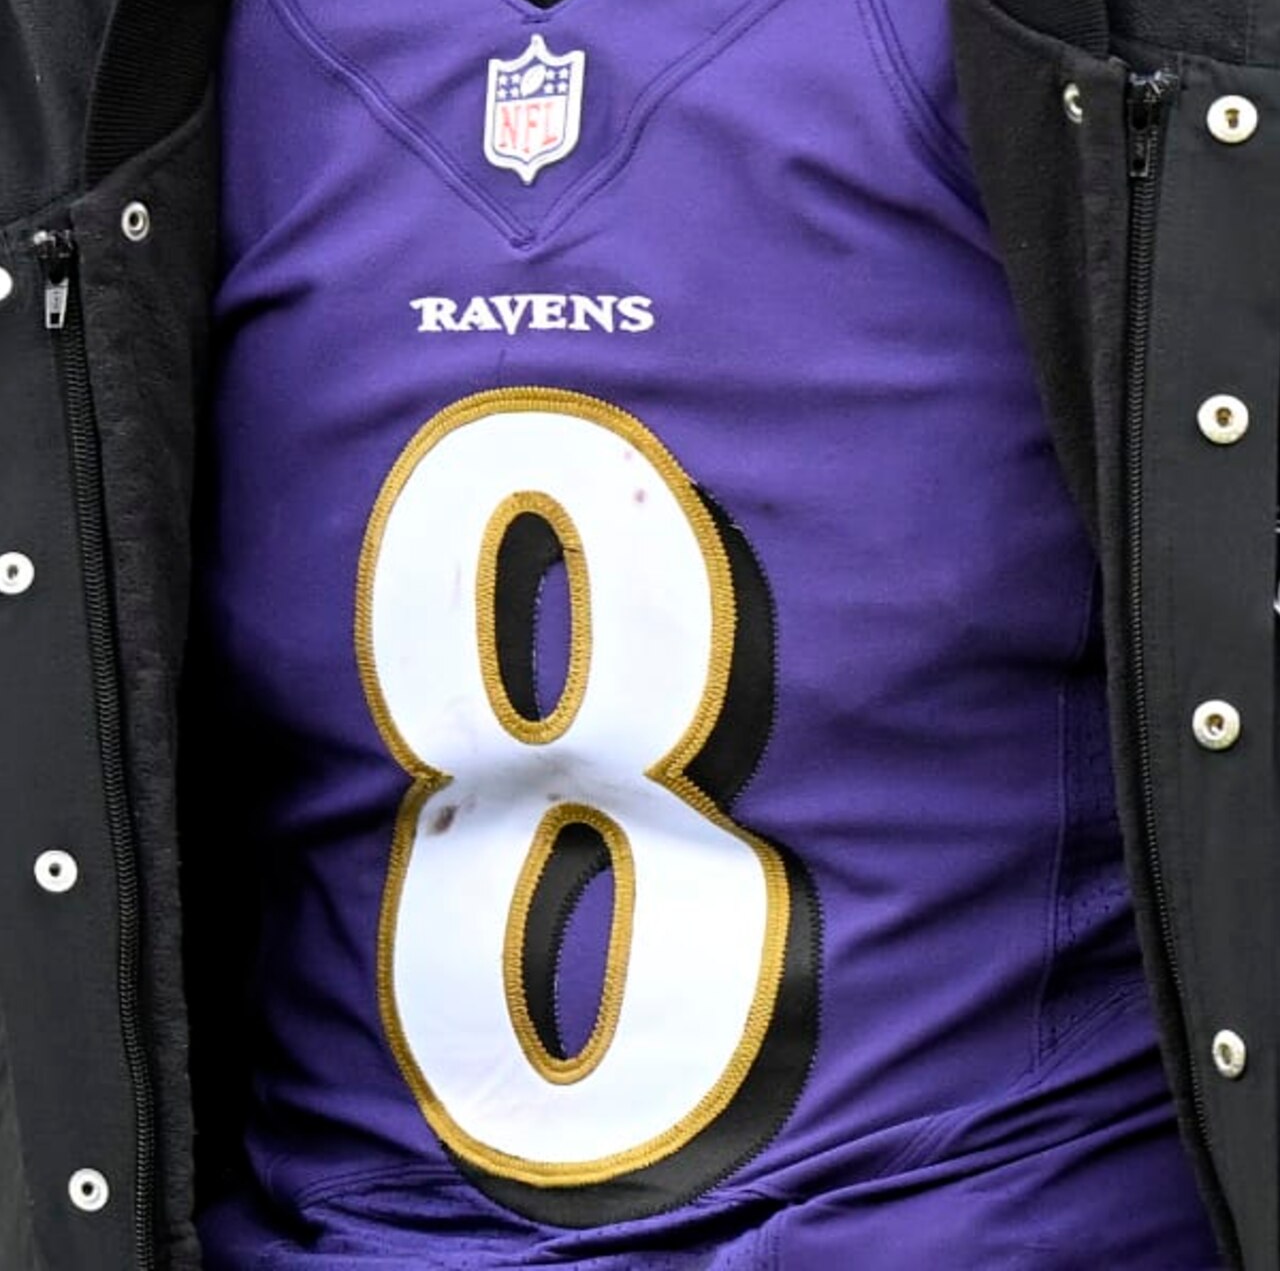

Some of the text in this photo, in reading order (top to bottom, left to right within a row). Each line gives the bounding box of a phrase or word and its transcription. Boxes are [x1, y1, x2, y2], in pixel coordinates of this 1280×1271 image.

[499, 101, 558, 153] NFL
[410, 293, 654, 335] RAVENS
[355, 387, 793, 1189] 8
